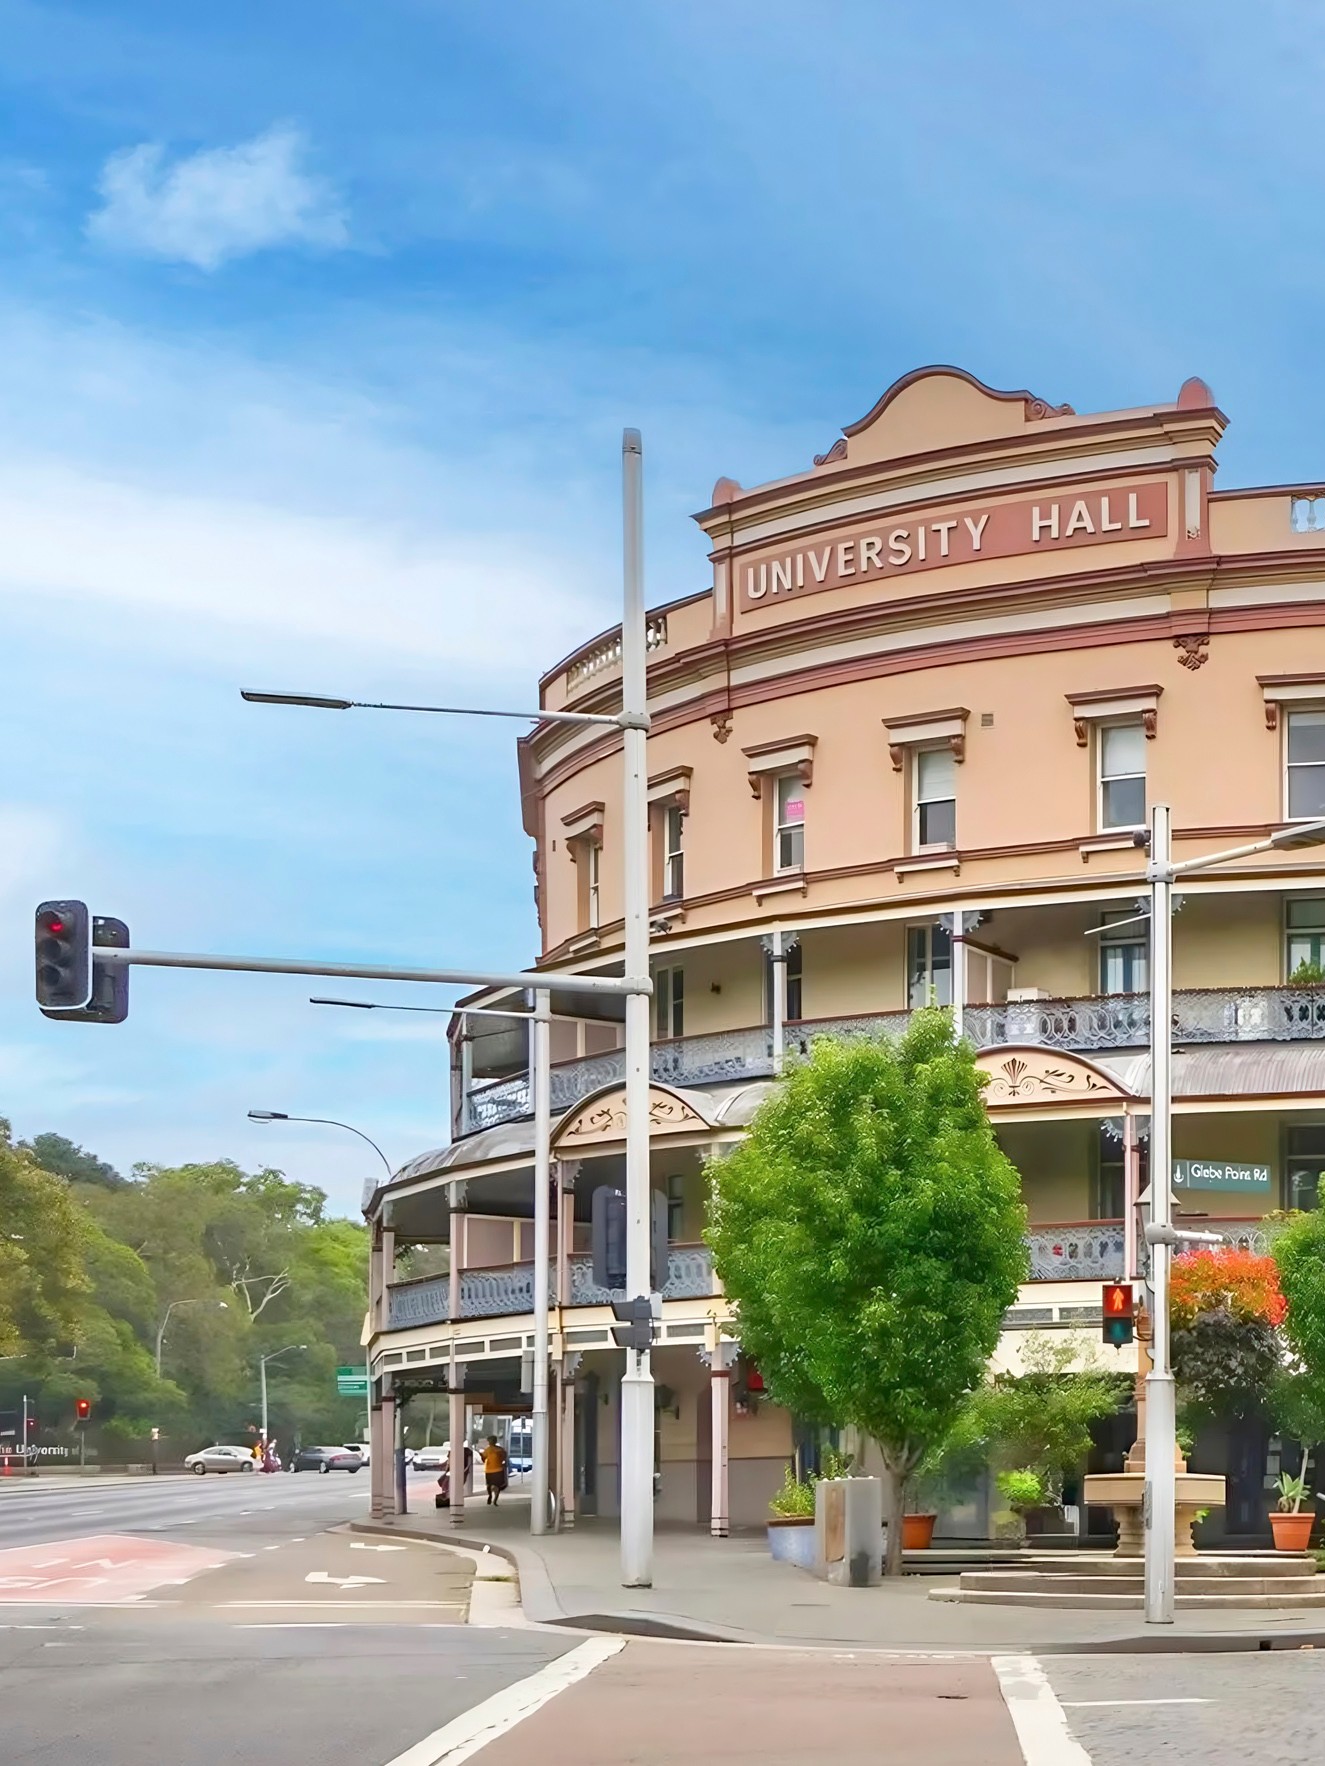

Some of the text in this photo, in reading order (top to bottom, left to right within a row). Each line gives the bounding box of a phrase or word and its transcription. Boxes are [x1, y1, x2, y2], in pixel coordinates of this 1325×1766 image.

[747, 492, 1151, 600] UNIVERSITY HALL
[1253, 1168, 1268, 1182] Rd
